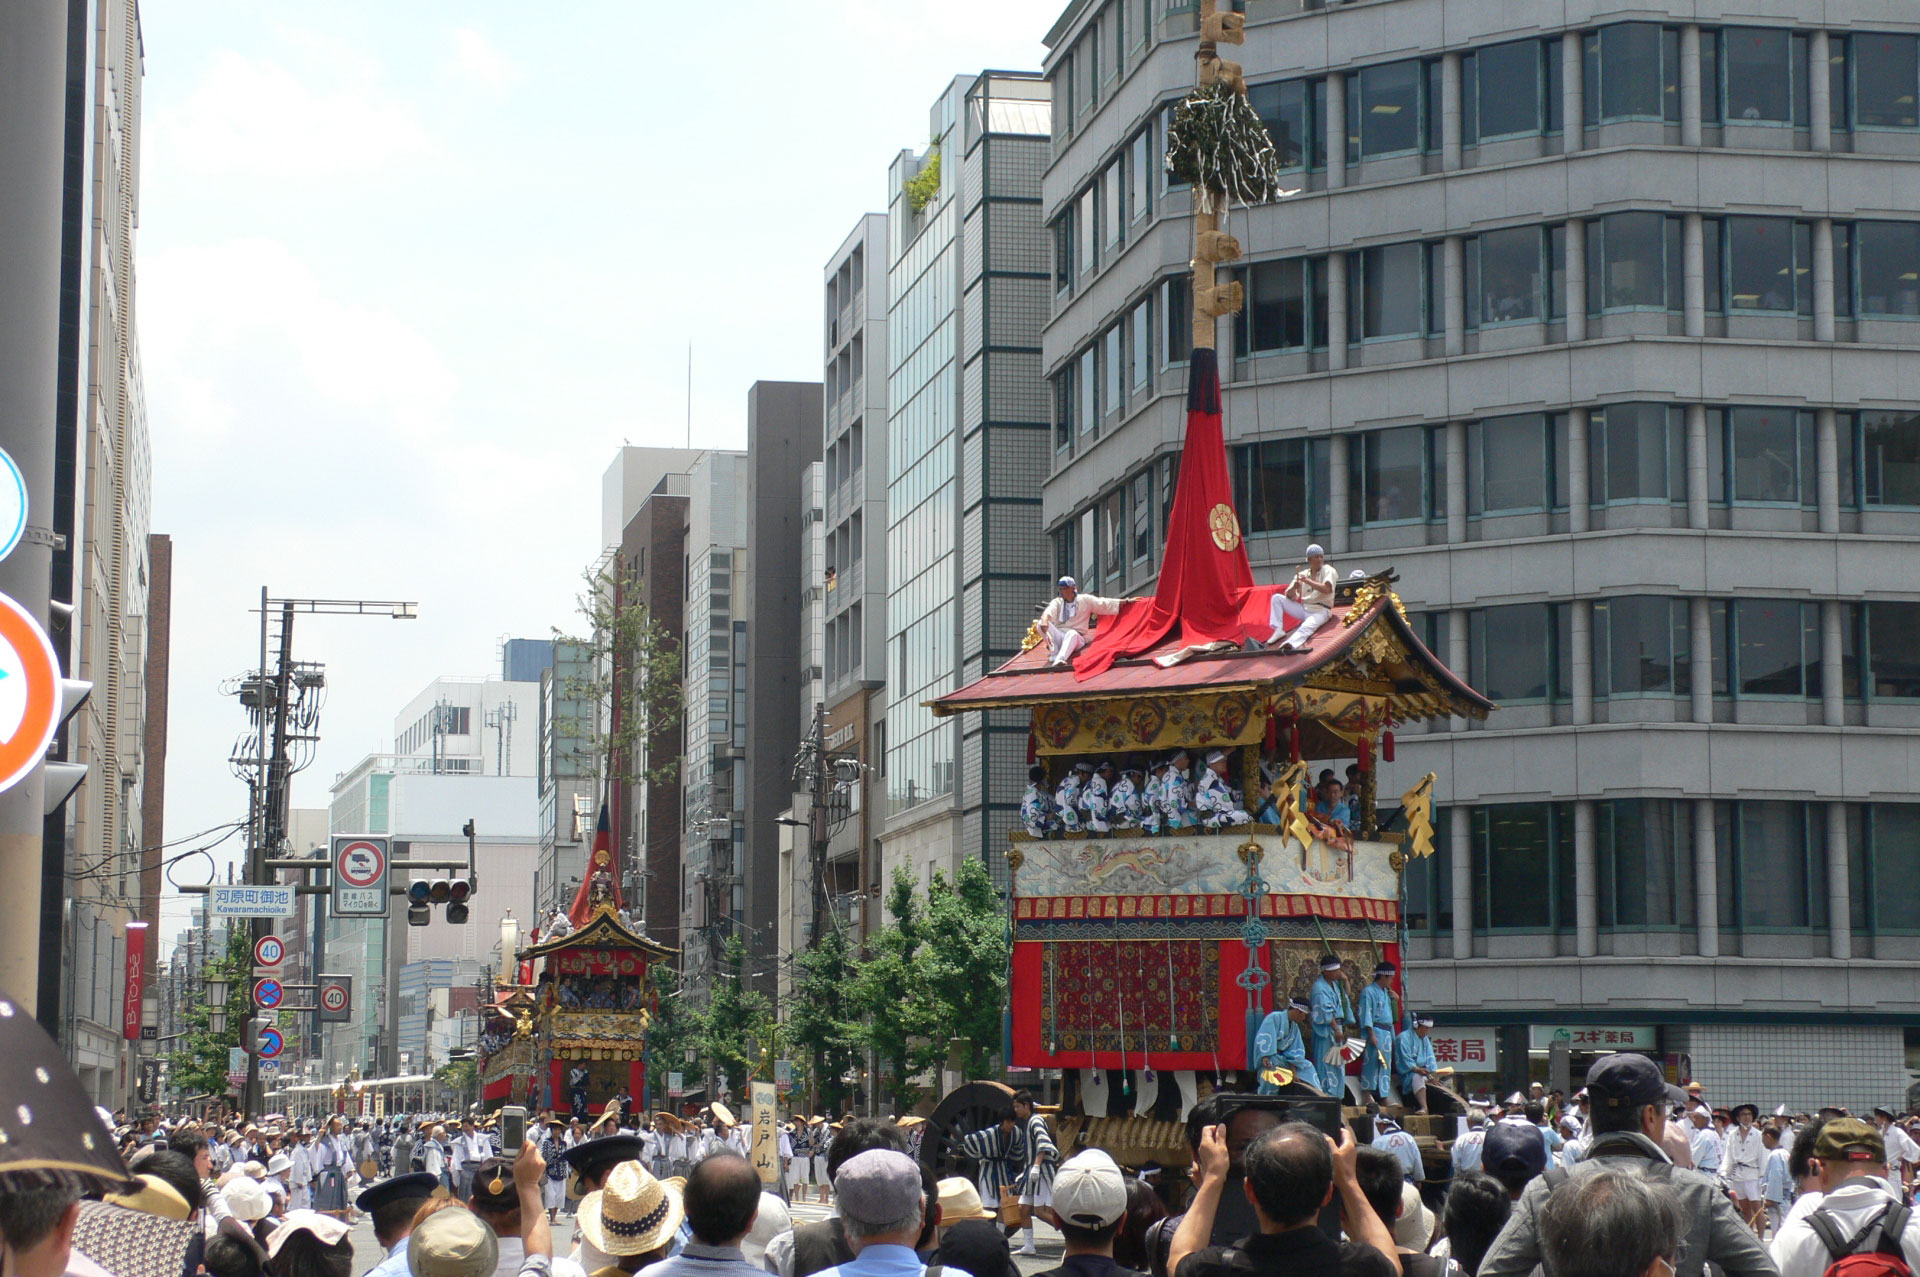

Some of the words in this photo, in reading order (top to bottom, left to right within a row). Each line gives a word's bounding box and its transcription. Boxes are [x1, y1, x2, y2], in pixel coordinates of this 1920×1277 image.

[216, 889, 289, 905] 河原町御池
[216, 905, 287, 914] Kawaramachioike
[262, 945, 279, 958] 40
[327, 993, 342, 1005] 40
[1572, 1029, 1634, 1043] スギ薬局
[1430, 1037, 1486, 1062] 薬局
[144, 1065, 155, 1100] girasole
[756, 1109, 771, 1168] 岩戸山
